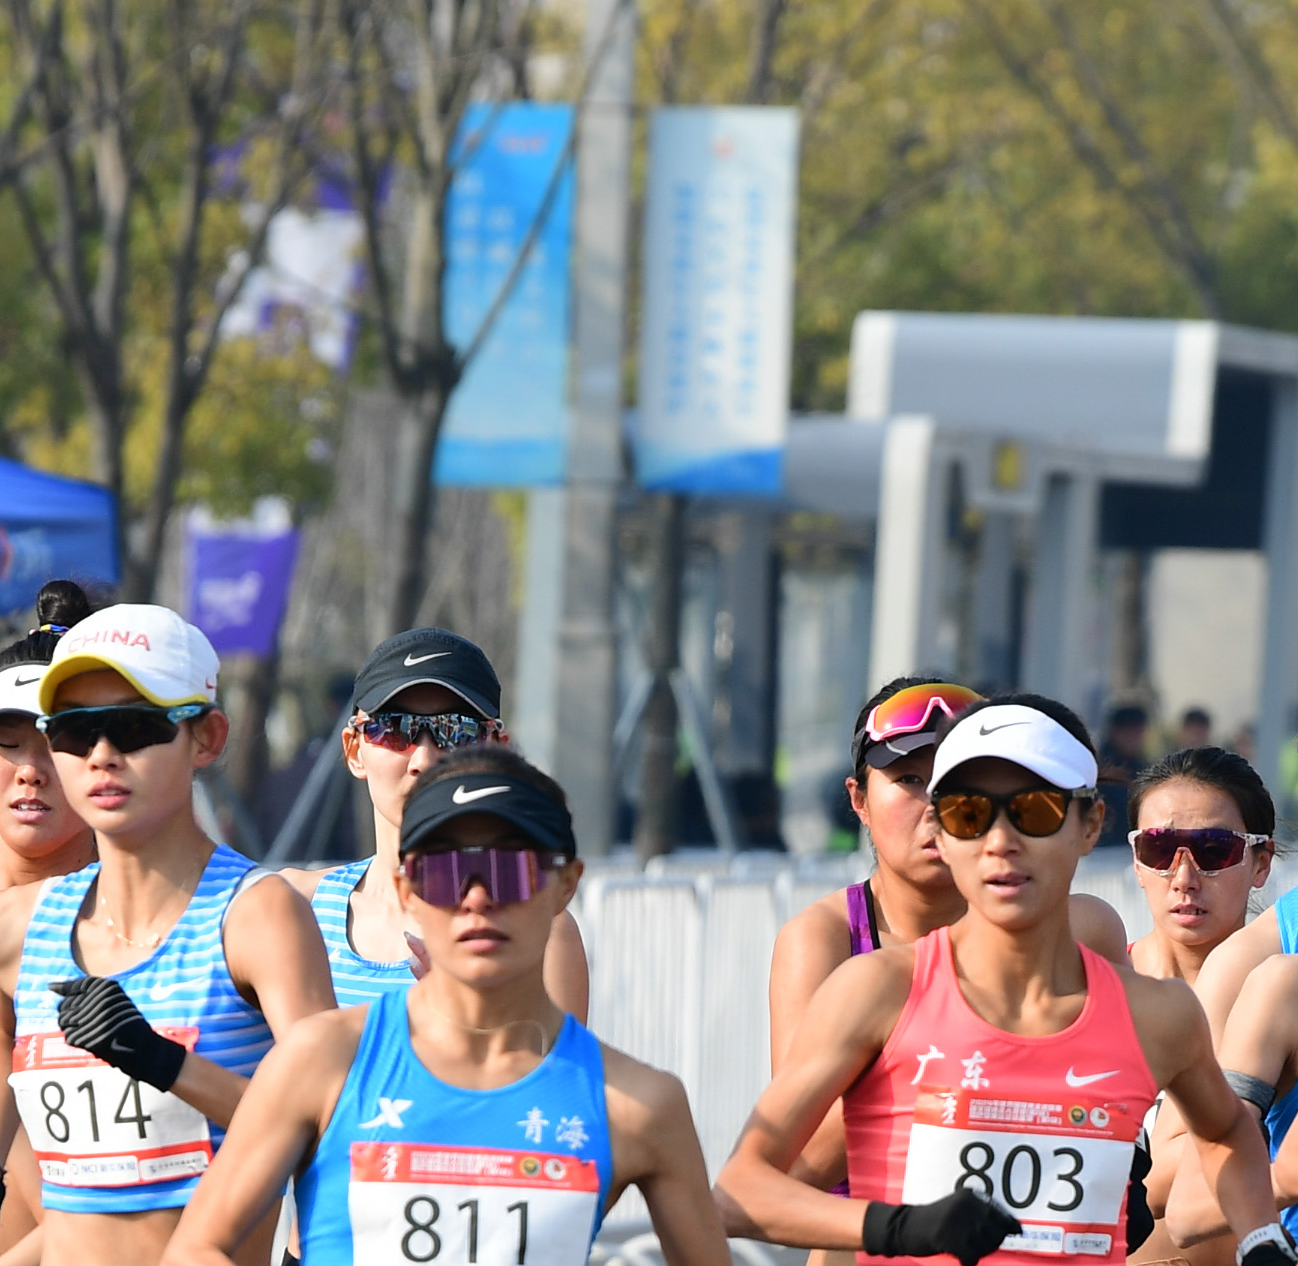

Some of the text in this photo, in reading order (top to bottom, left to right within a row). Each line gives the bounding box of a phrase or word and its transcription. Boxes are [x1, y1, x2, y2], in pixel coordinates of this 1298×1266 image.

[68, 629, 152, 653] CHINA
[910, 1045, 990, 1090] 广东
[40, 1077, 152, 1143] 814
[517, 1106, 590, 1149] 青海
[955, 1141, 1084, 1211] 803
[402, 1196, 529, 1265] 811
